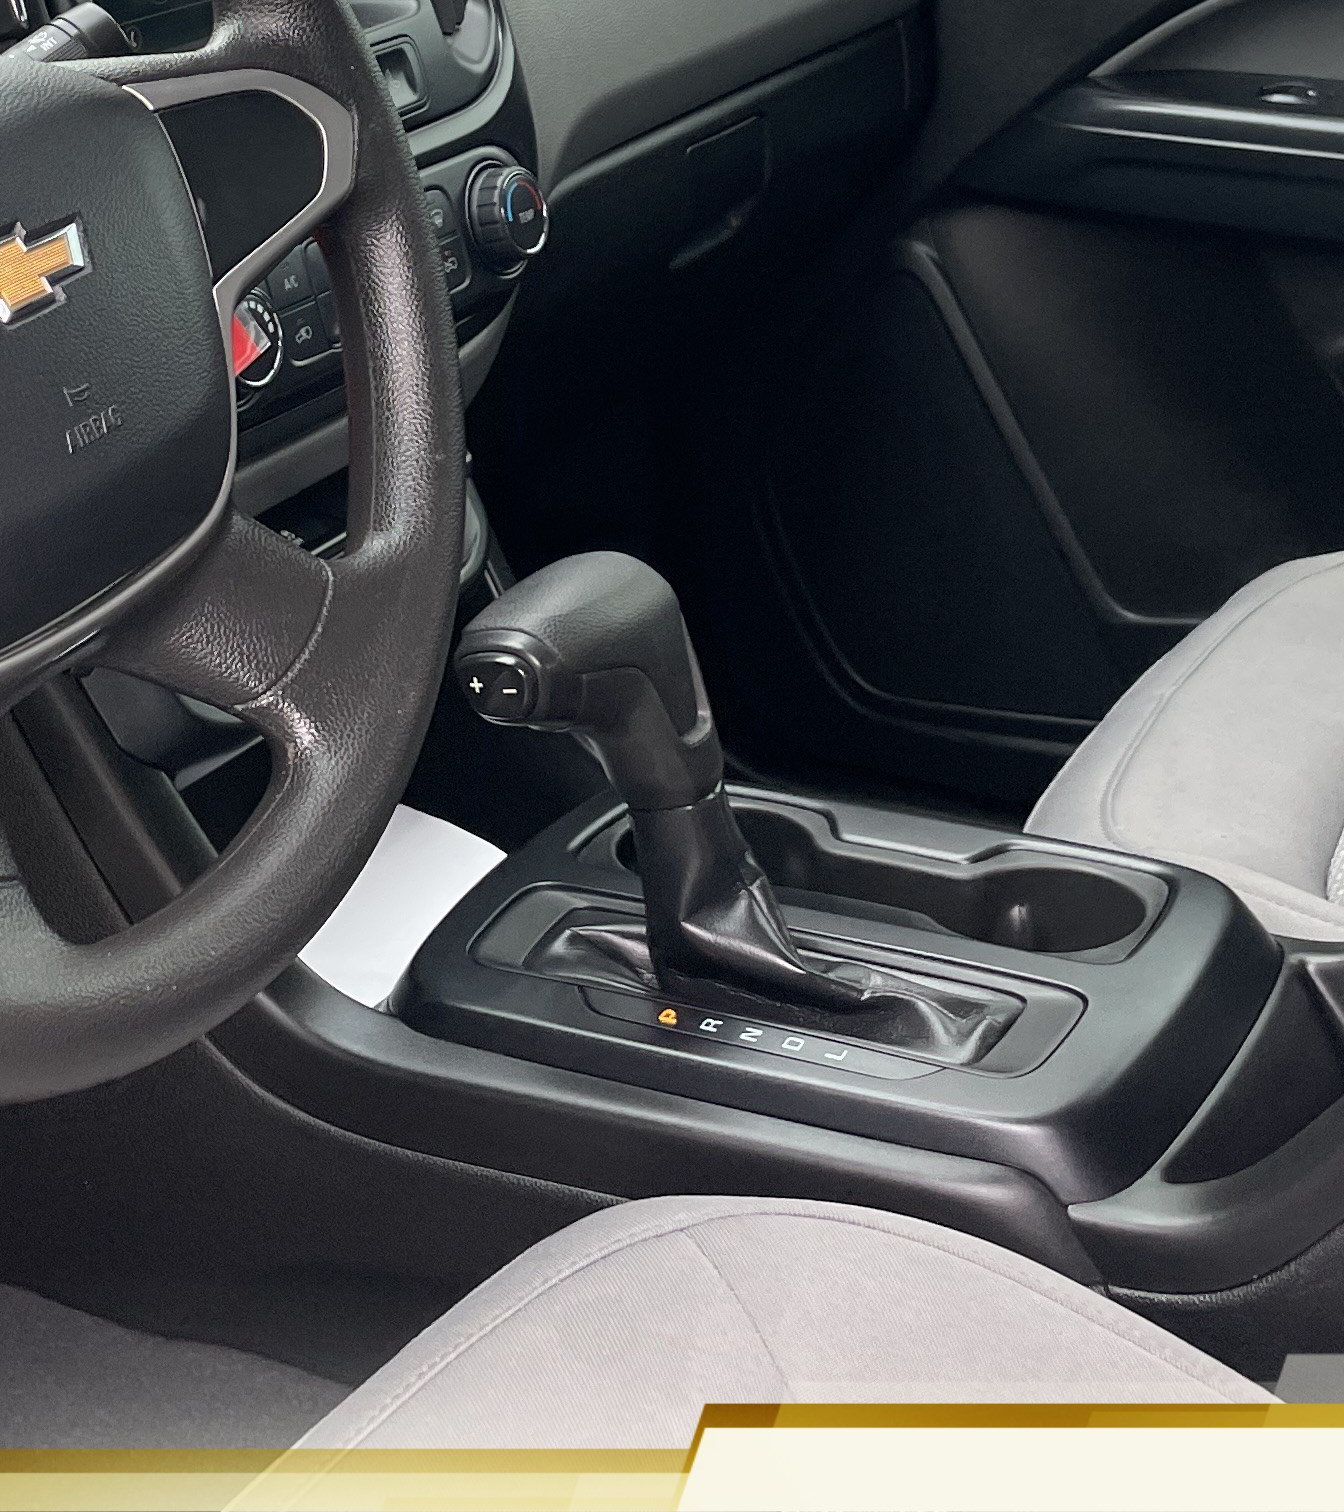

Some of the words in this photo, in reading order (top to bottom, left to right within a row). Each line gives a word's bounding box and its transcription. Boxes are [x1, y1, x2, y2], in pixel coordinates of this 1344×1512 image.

[699, 1018, 724, 1033] R
[739, 1027, 764, 1043] N
[781, 1036, 805, 1051] D
[824, 1049, 848, 1062] L
